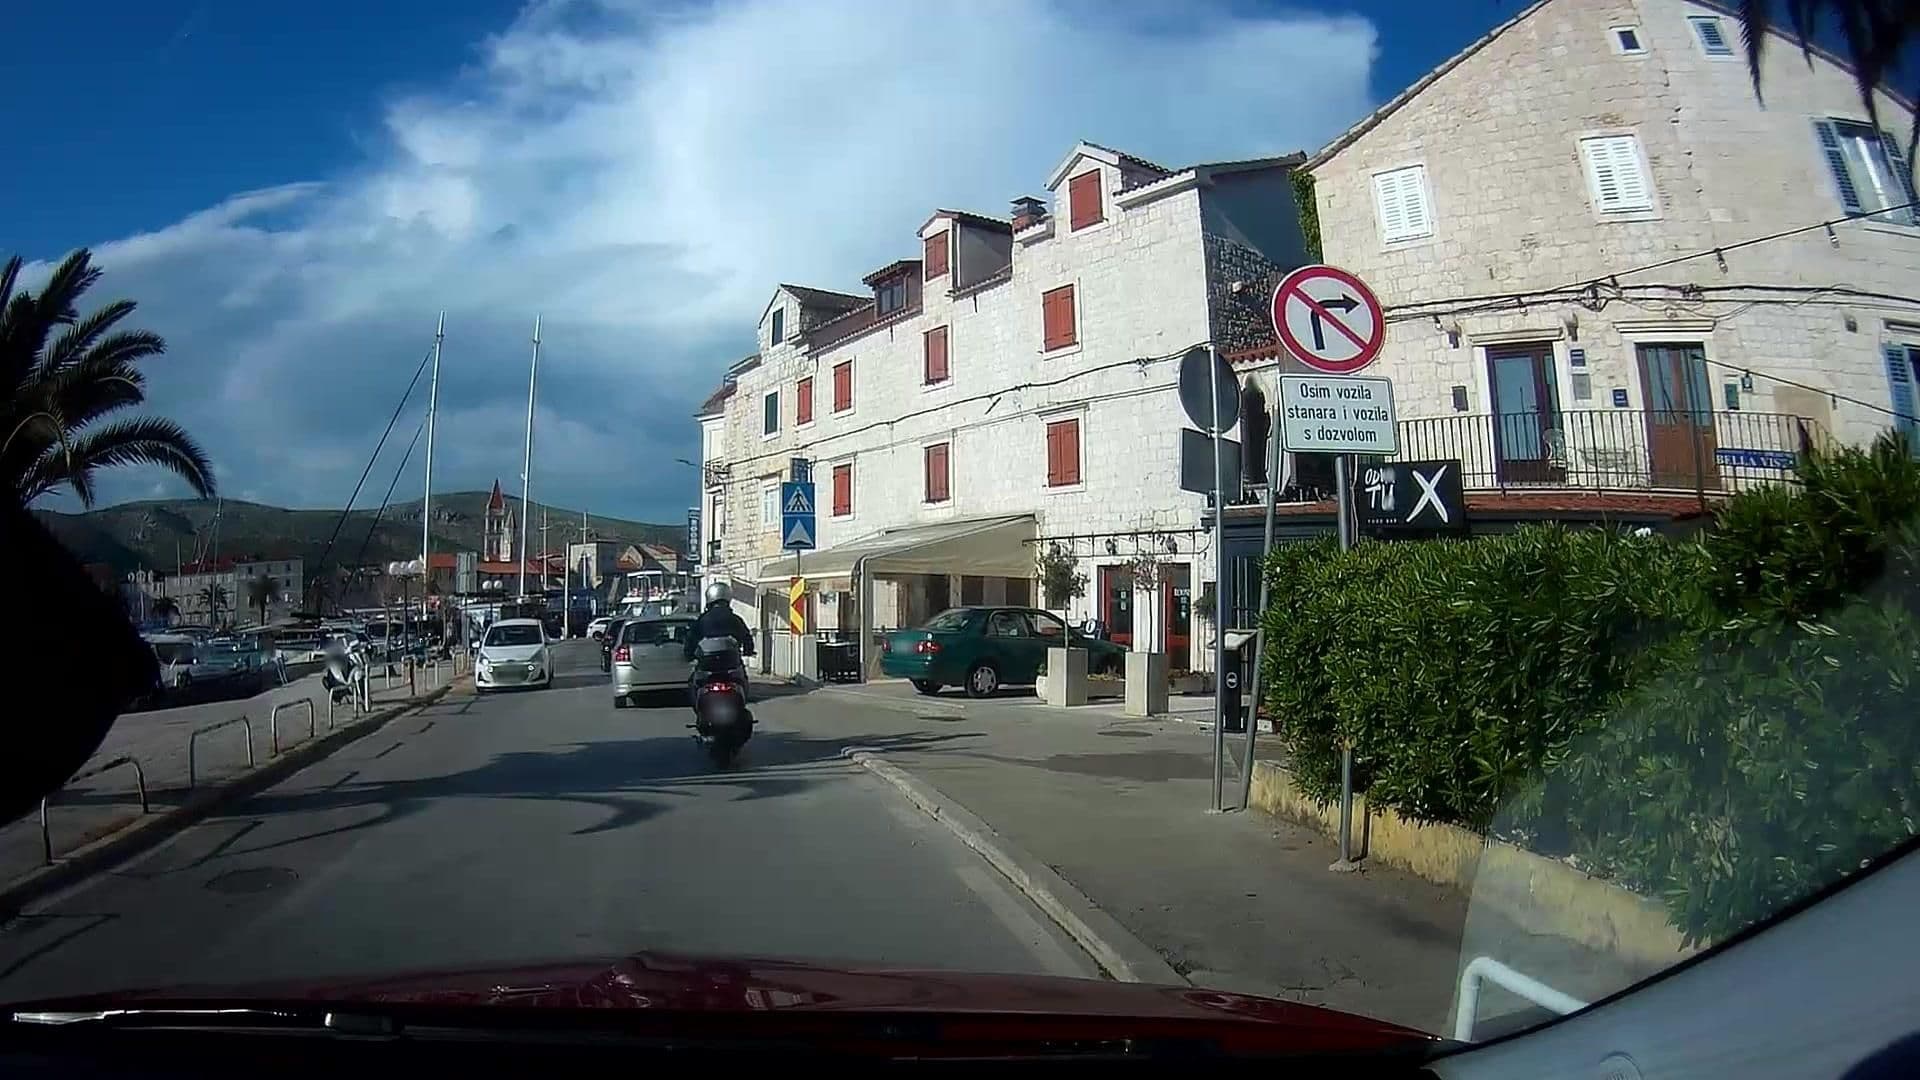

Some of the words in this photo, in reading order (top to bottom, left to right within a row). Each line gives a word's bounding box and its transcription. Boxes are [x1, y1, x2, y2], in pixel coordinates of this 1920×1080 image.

[1300, 383, 1331, 399] Osim
[1336, 384, 1372, 400] vozila
[1287, 404, 1337, 419] stanara
[1342, 405, 1347, 420] i
[1353, 406, 1389, 421] vozila
[1304, 428, 1312, 440] s
[1317, 425, 1377, 442] dozvolom
[1716, 454, 1757, 467] BELLA
